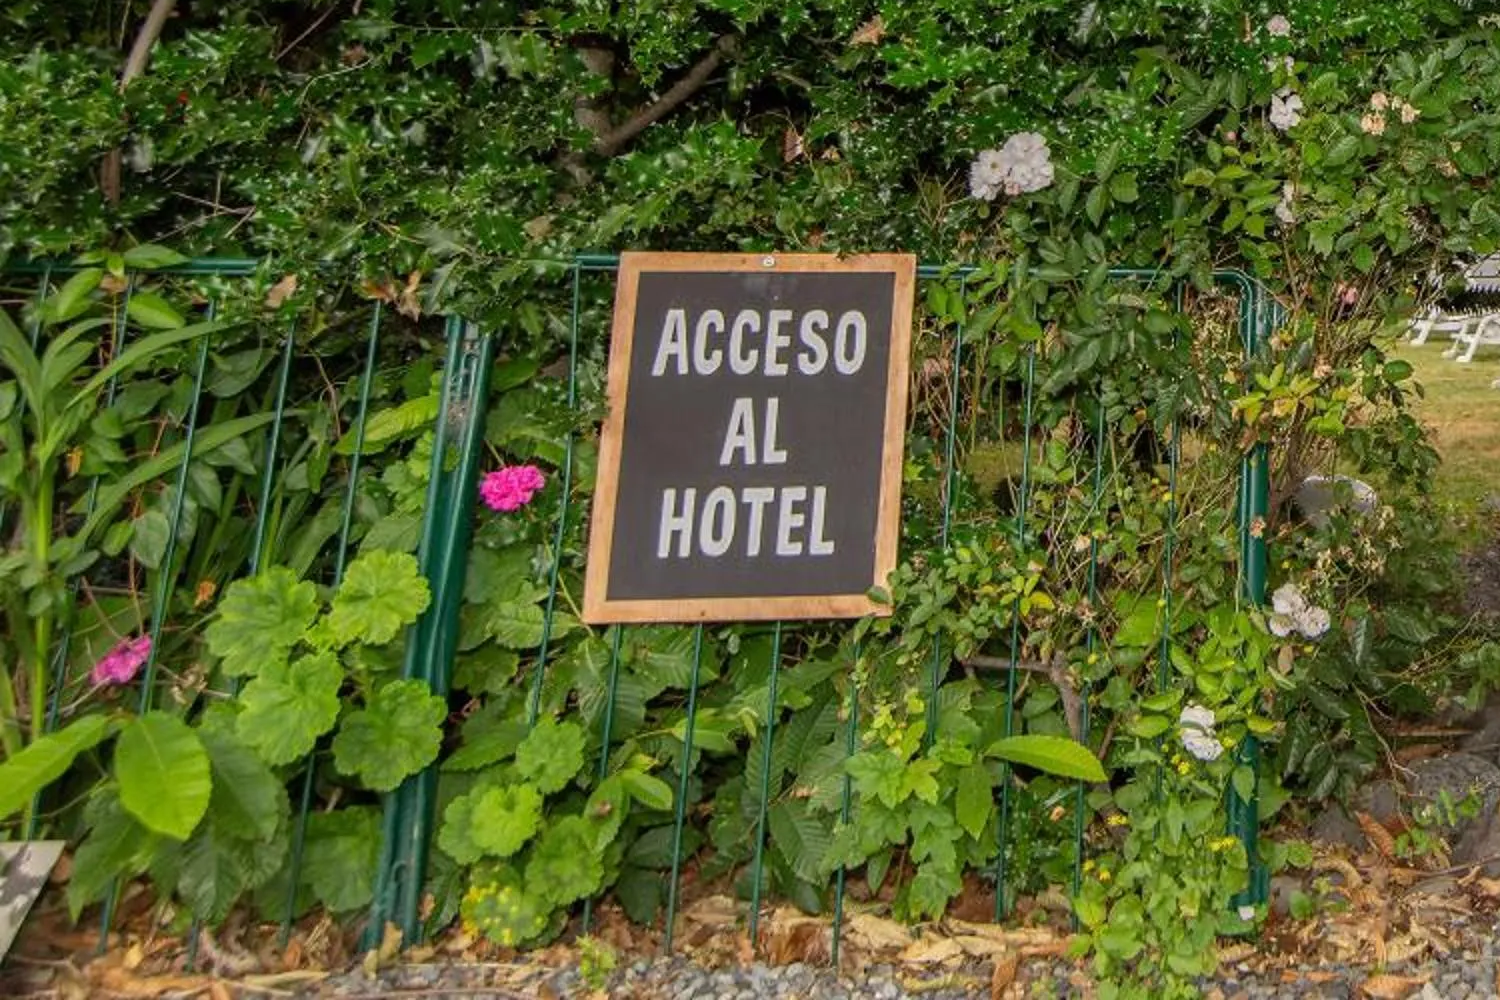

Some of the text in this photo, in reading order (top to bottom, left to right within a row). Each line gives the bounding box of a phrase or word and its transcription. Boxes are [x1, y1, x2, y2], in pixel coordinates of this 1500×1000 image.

[651, 308, 868, 377] ACCESO
[719, 397, 788, 465] AL
[656, 486, 836, 559] HOTEL
